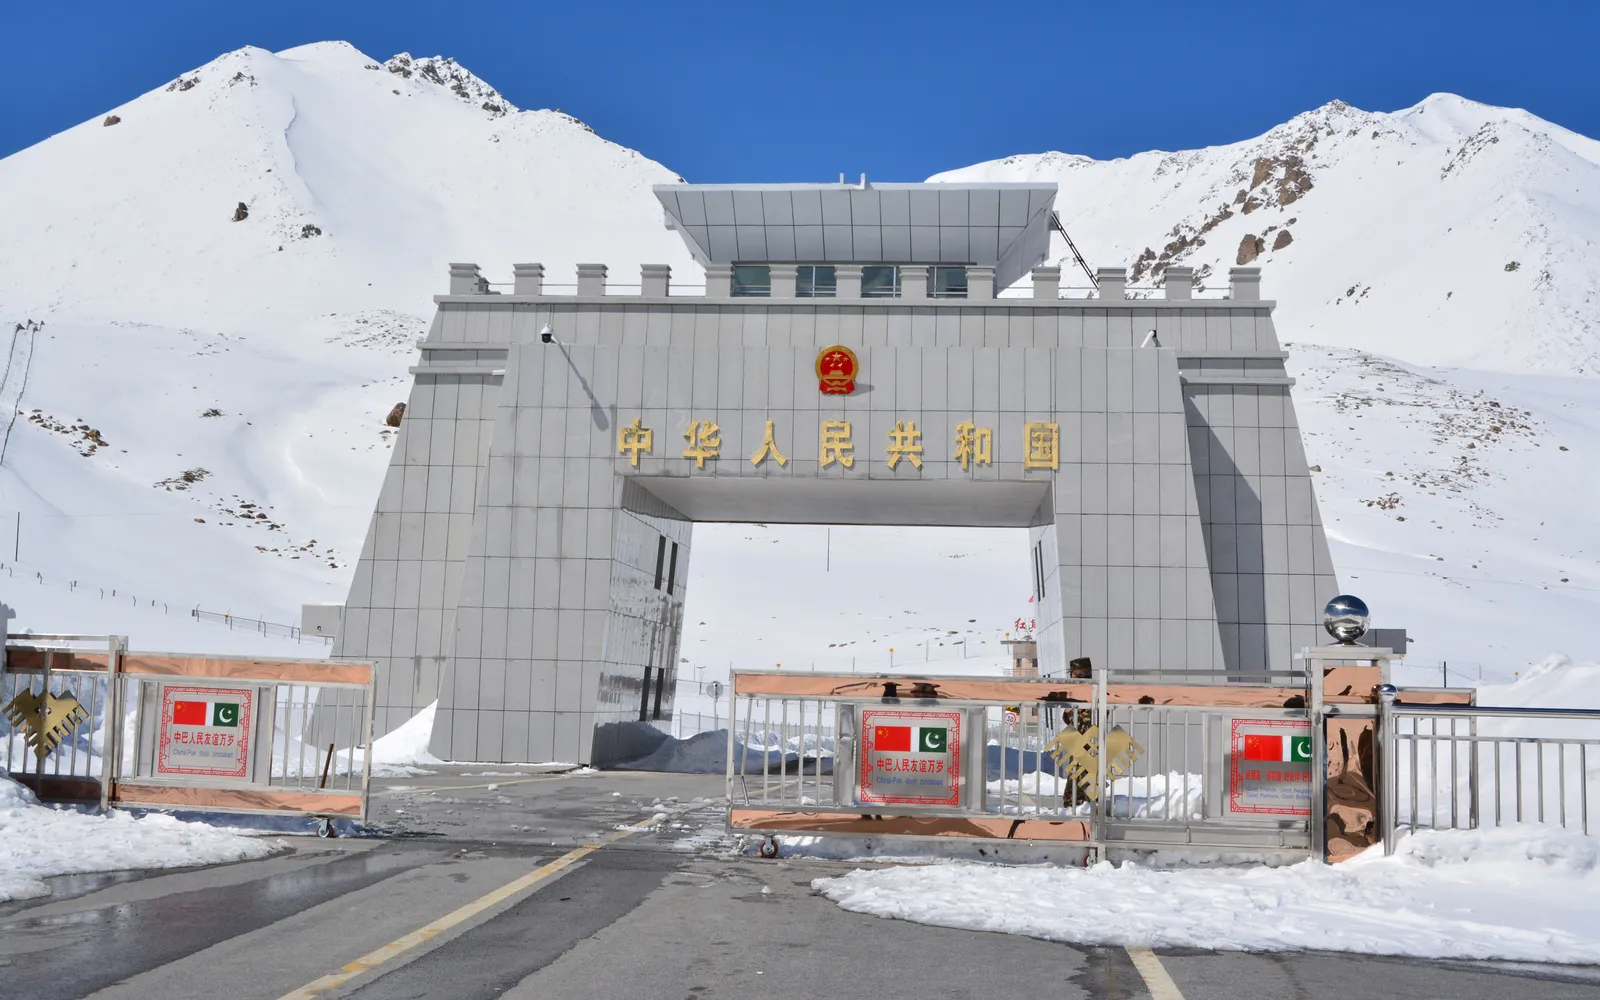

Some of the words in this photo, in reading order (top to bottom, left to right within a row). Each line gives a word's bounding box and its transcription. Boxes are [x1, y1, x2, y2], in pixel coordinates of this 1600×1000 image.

[618, 418, 1060, 470] 中华人民共和国
[174, 731, 235, 746] 中巴人民友谊万岁
[876, 757, 944, 773] 中巴人民友谊万岁
